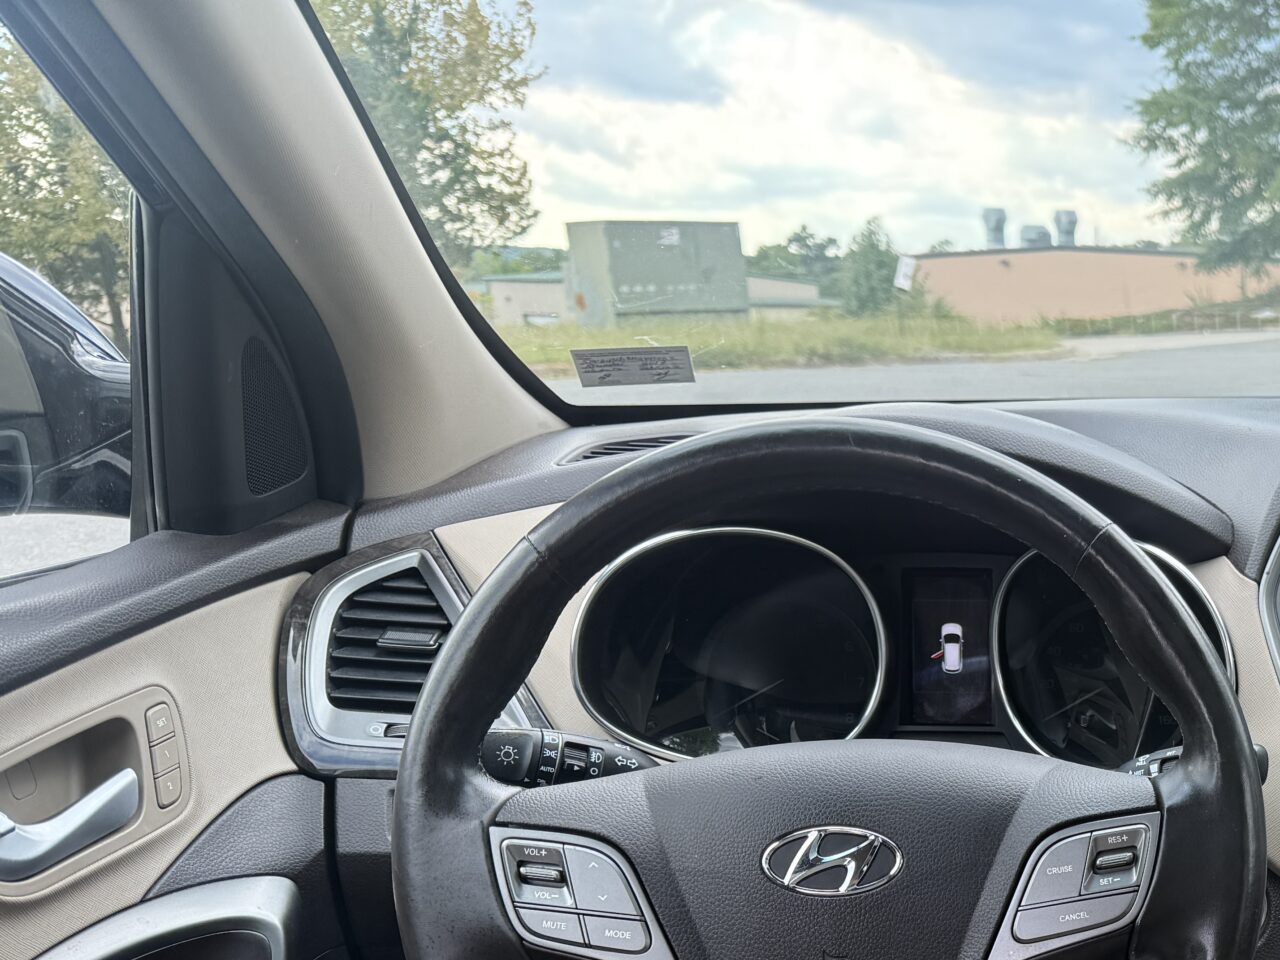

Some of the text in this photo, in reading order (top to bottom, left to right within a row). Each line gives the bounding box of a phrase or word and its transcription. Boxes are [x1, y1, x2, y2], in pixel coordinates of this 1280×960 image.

[1108, 834, 1128, 844] RES+
[524, 847, 547, 856] VOL+
[1047, 864, 1073, 876] CRUISE
[1059, 912, 1090, 922] CANCEL
[542, 920, 567, 930] MUTE
[604, 929, 632, 939] MODE
